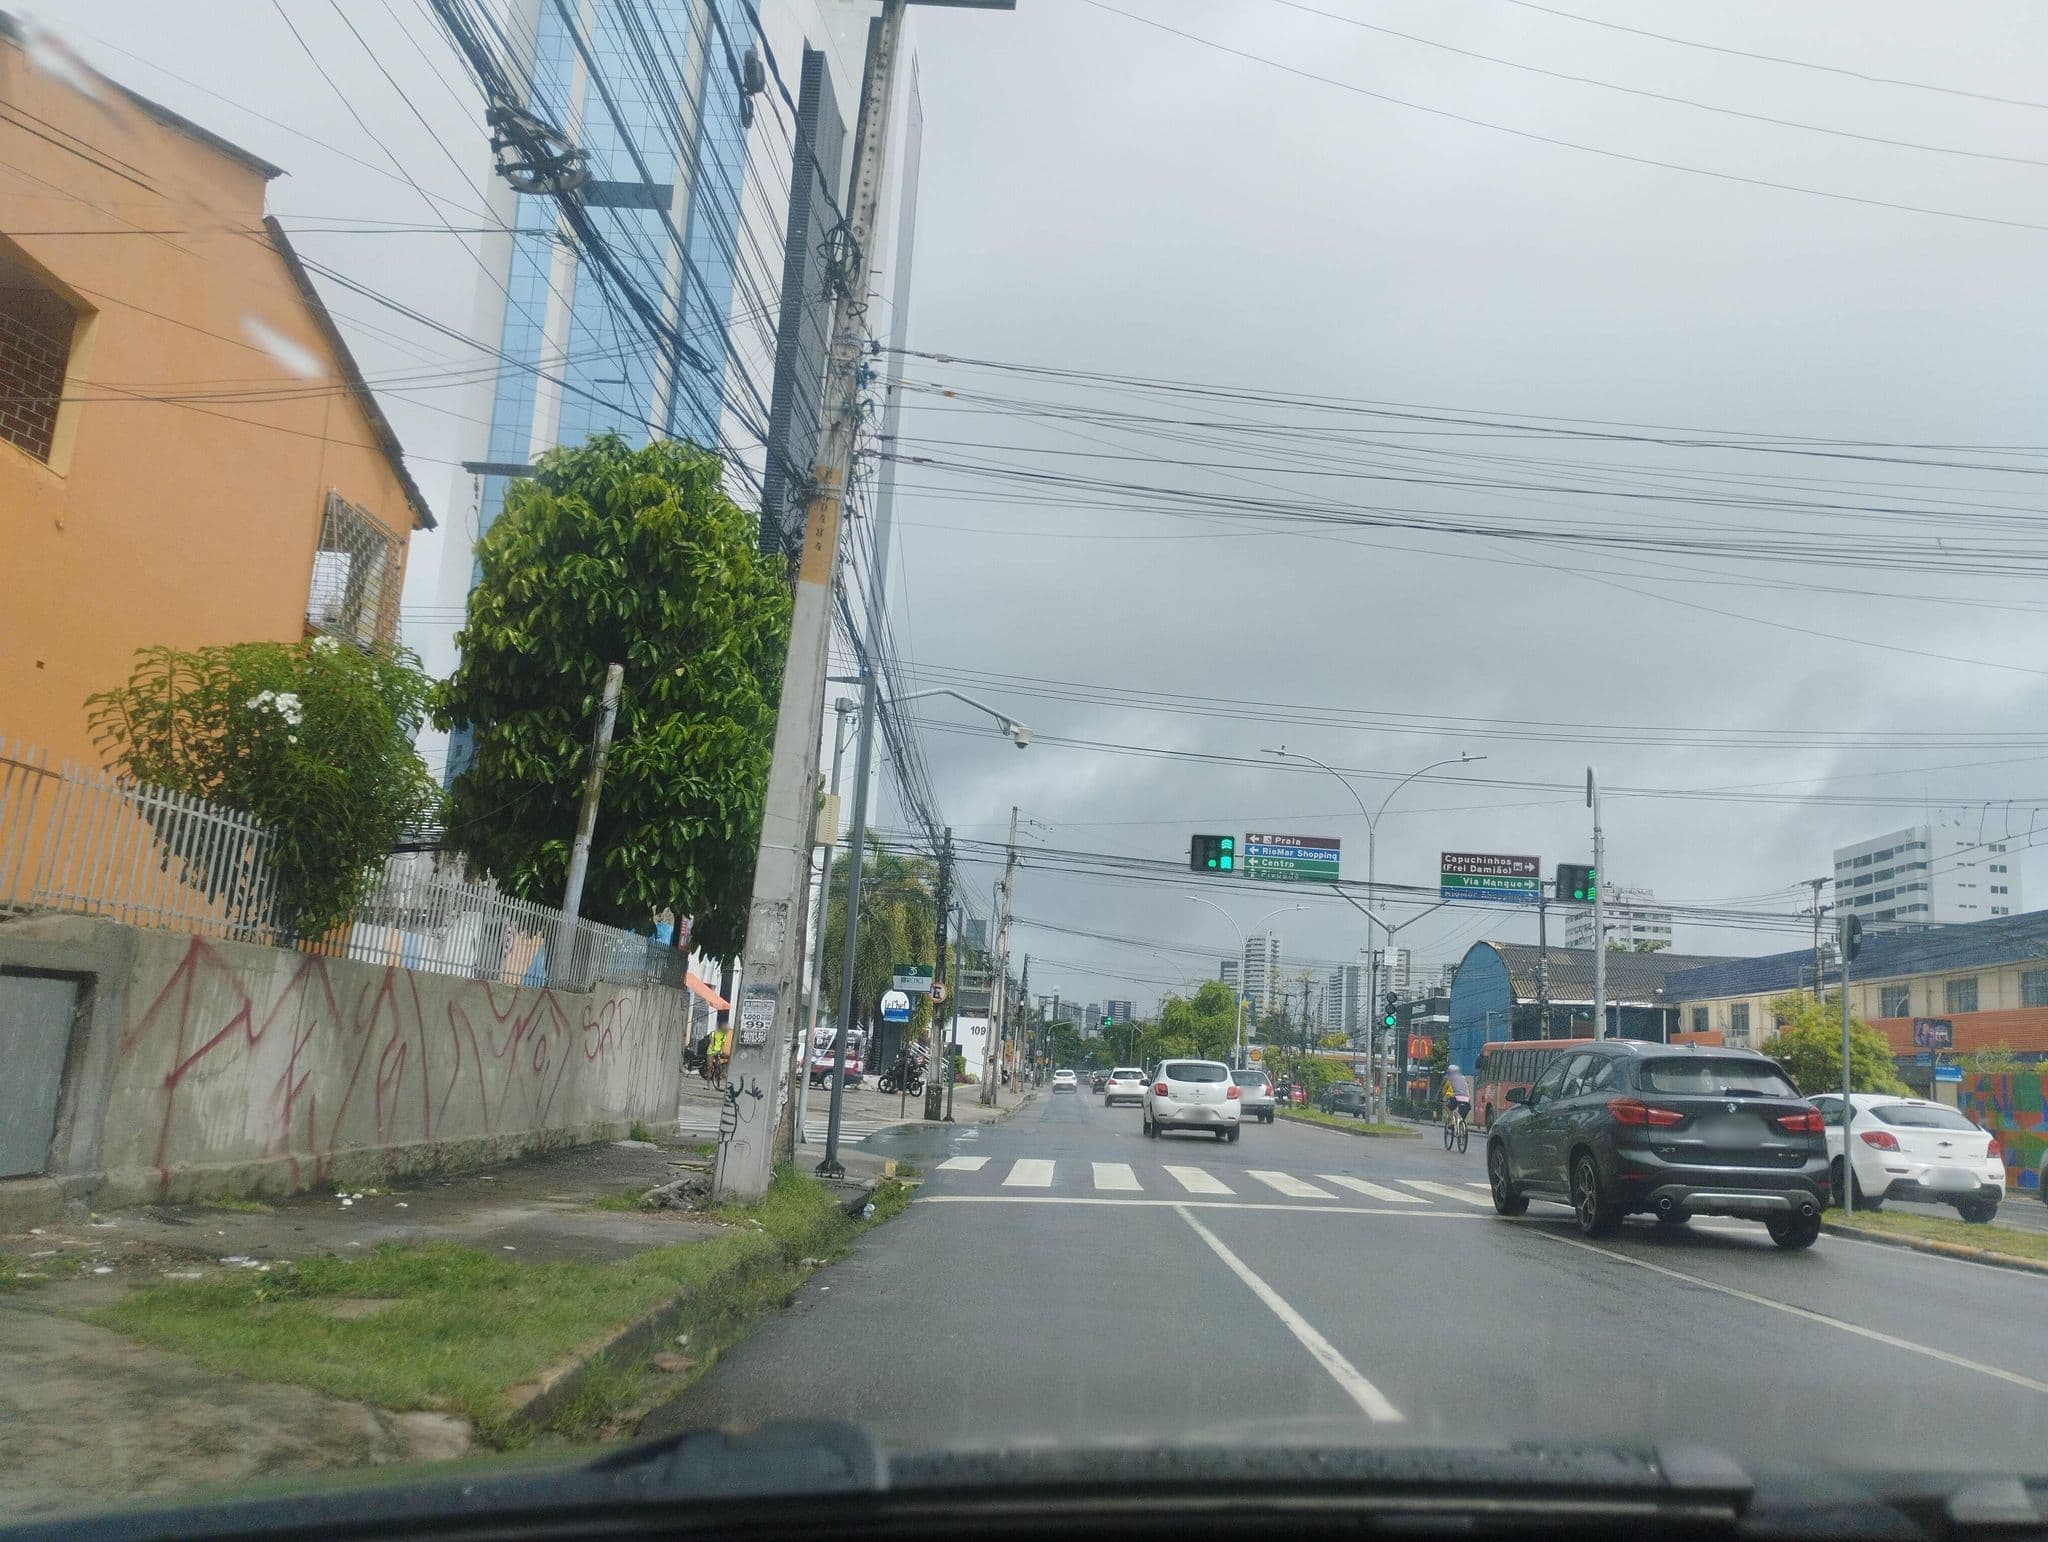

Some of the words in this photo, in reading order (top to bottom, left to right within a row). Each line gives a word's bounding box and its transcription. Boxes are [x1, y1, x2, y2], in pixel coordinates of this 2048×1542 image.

[1275, 836, 1301, 846] Praia
[1262, 847, 1294, 857] RioMar
[1297, 849, 1338, 861] Shopping
[1261, 859, 1295, 868] Centro
[1444, 854, 1512, 865] Capuchinhos
[1442, 863, 1466, 872] (Frei
[1463, 876, 1479, 886] Via
